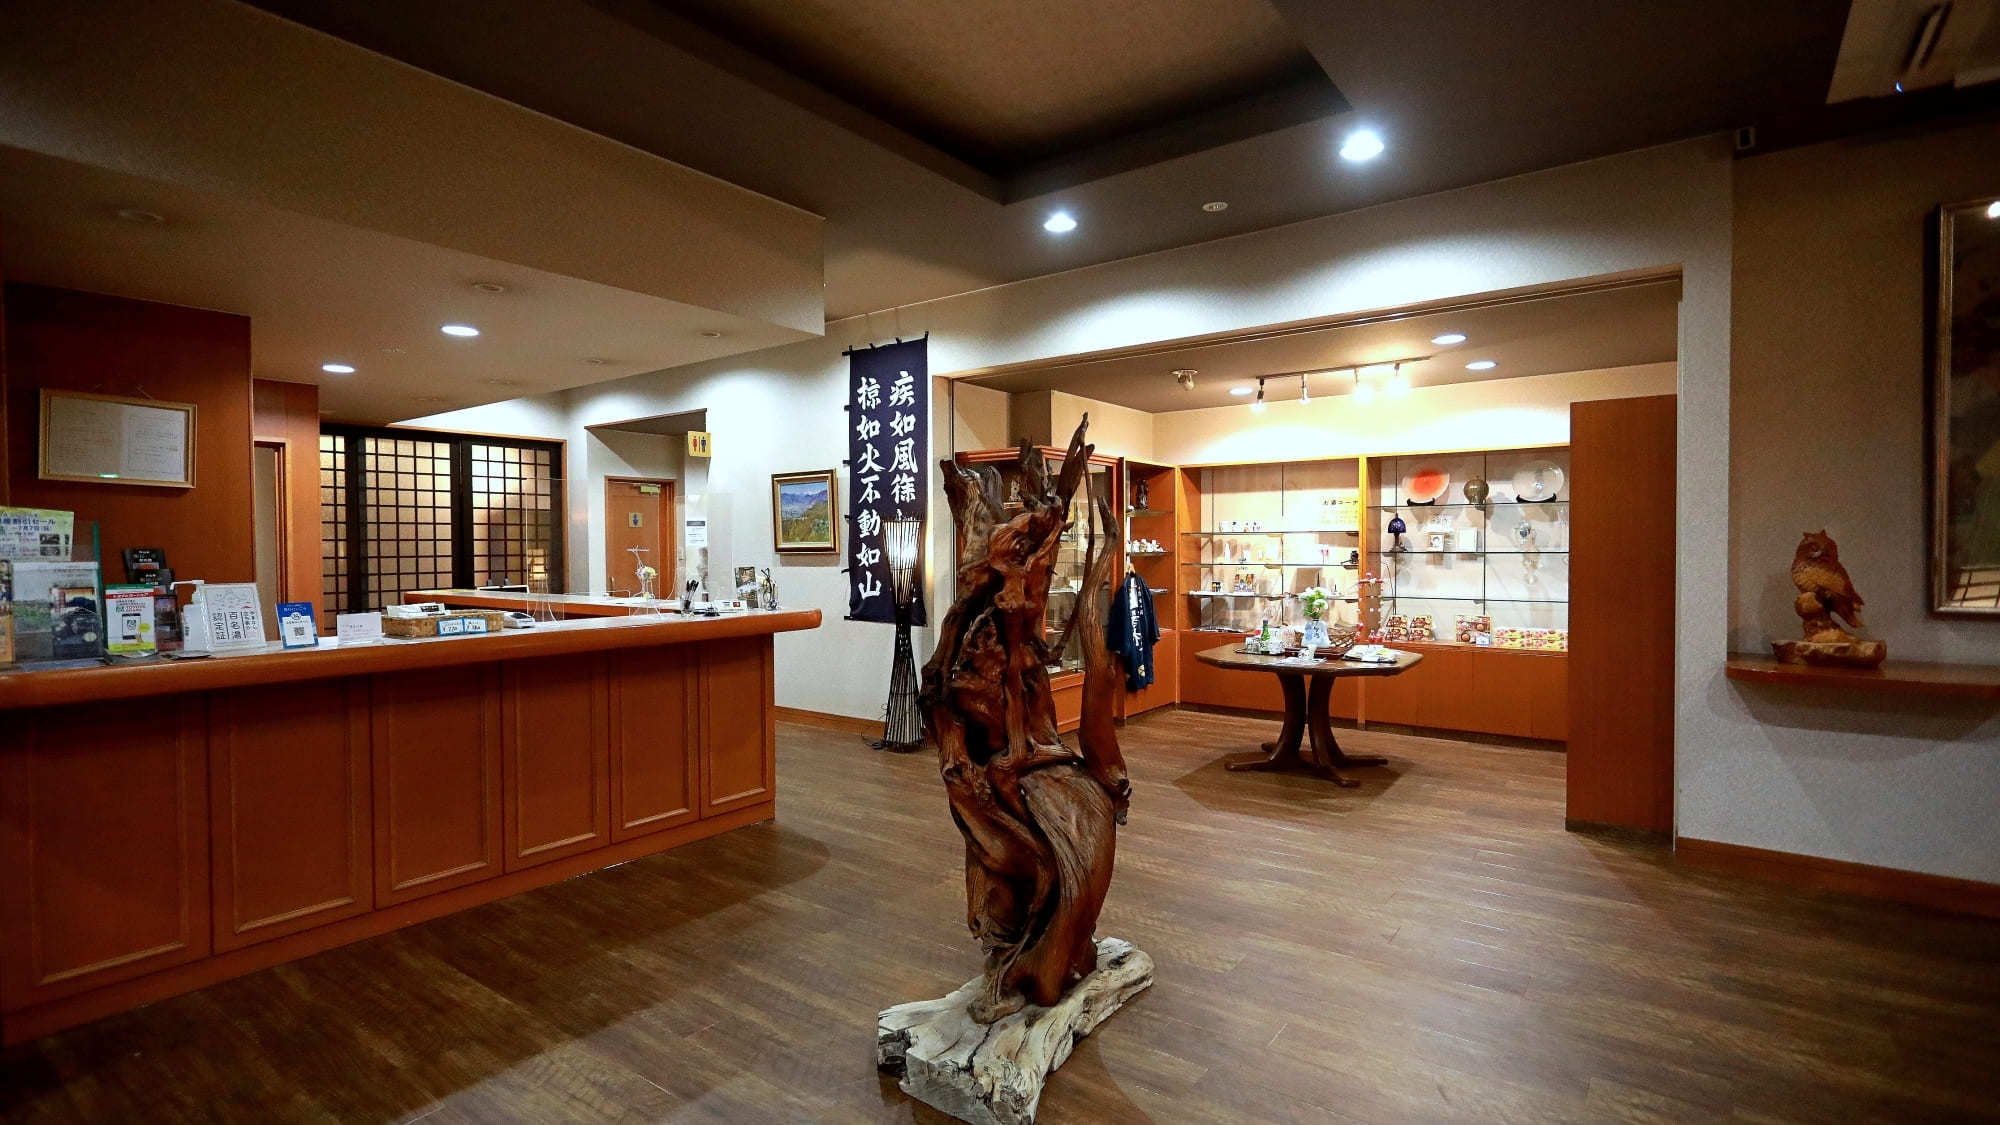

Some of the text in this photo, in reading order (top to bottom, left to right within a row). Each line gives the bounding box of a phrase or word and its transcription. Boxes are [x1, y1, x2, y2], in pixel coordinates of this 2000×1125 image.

[855, 376, 886, 599] 掠如火不動如山
[888, 370, 919, 604] 疾如風徐
[212, 611, 226, 640] 認定証
[228, 611, 242, 640] 百名湯
